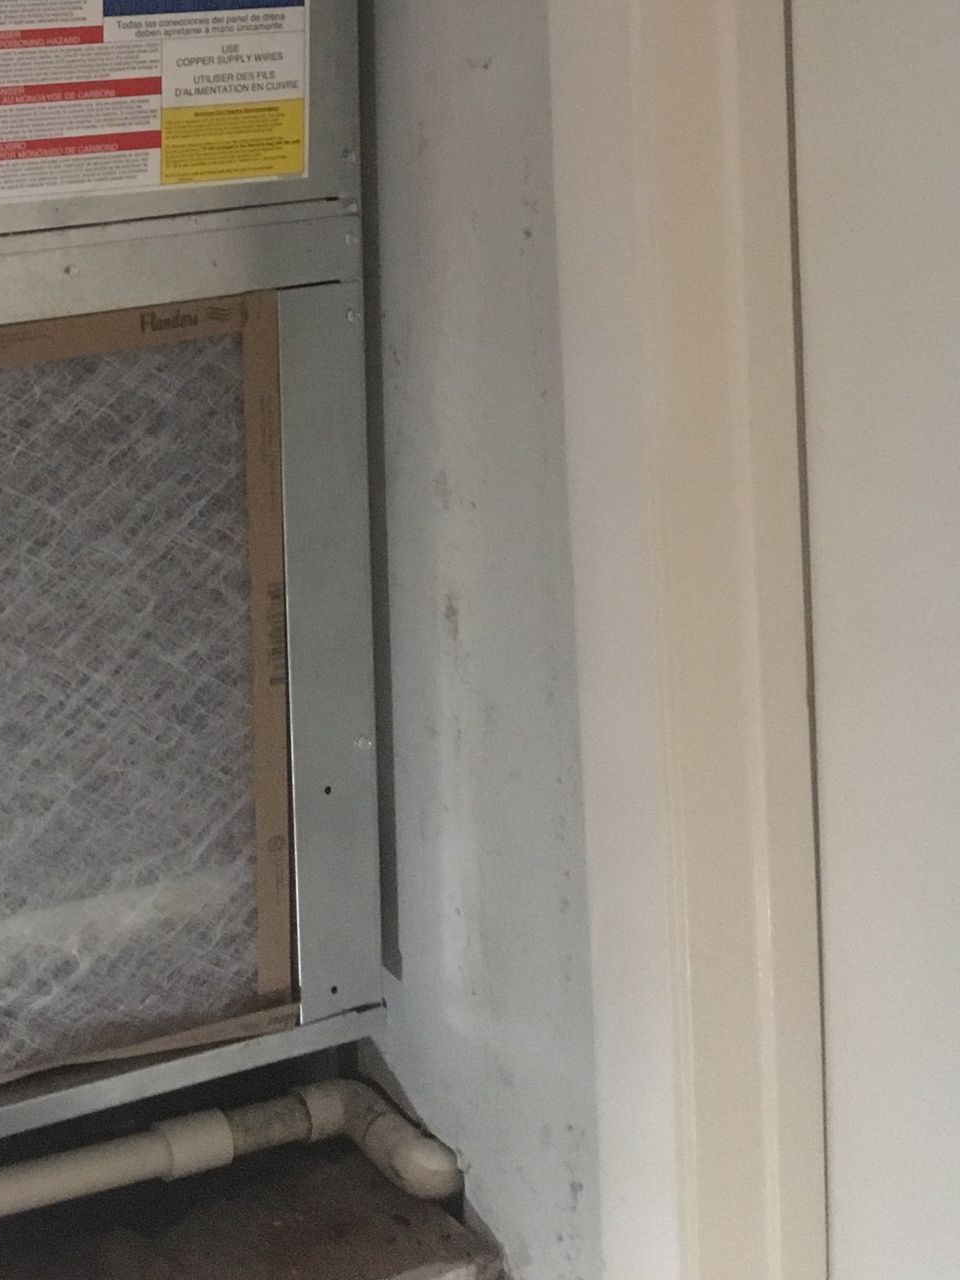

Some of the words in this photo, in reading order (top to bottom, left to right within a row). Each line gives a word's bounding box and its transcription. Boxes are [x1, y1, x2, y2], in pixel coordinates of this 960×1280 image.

[116, 20, 143, 30] Todas
[144, 19, 157, 28] las
[158, 16, 210, 28] conecciones
[135, 29, 162, 38] deben
[212, 24, 235, 33] mano
[221, 44, 240, 53] USE
[176, 56, 214, 67] COPPER
[216, 54, 252, 65] SUPPLY
[254, 52, 284, 62] WIRES
[193, 73, 234, 84] UTILISER
[236, 72, 255, 81] DES
[257, 70, 276, 80] FILS
[175, 83, 249, 97] D'ALIMENTATION
[251, 82, 265, 91] EN
[266, 80, 299, 91] CUIVRE
[140, 308, 200, 335] Flanders
